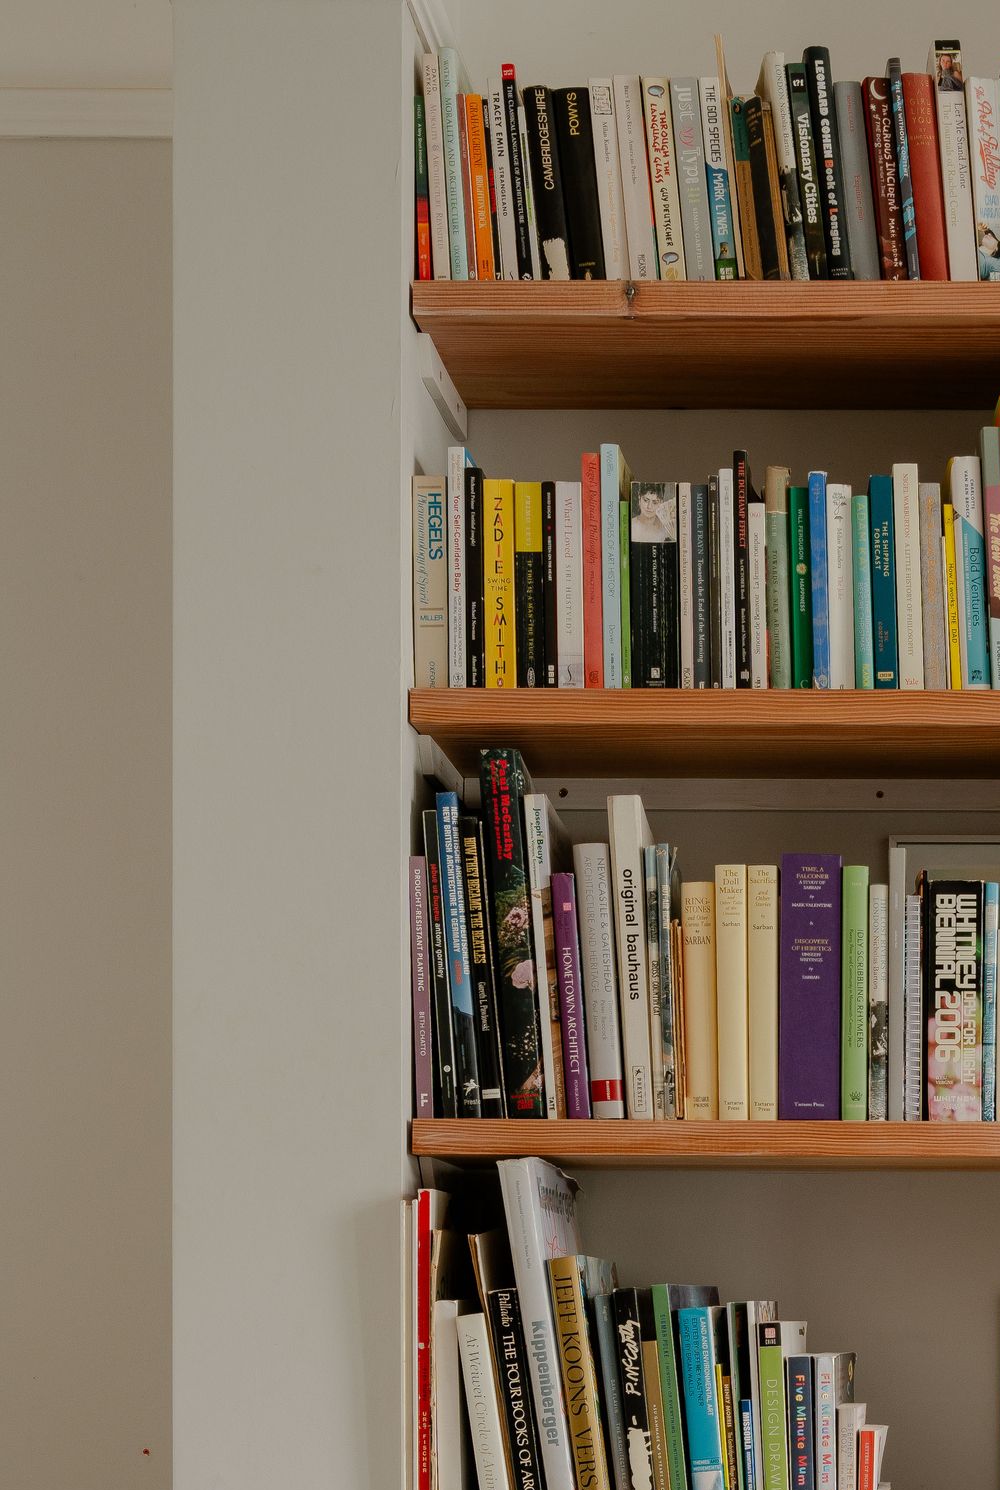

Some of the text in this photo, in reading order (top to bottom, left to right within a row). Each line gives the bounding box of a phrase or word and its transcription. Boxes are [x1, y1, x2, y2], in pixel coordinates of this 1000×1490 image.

[566, 92, 580, 135] POWYS
[814, 60, 828, 115] LEONARD
[445, 98, 455, 144] MORALITY
[534, 89, 554, 190] CAMBRIDGESHIRE
[650, 103, 663, 183] LANGUAGE GLASS
[659, 111, 669, 157] THROUGH
[705, 86, 721, 163] THE GOD SPECIES
[820, 119, 832, 159] COHEN
[448, 148, 456, 167] AND
[492, 92, 507, 216] TRACEY EMIN STRANGELAND
[797, 113, 818, 223] Visionary Cities
[824, 159, 835, 189] Book
[449, 170, 460, 234] ARCHITECTURE
[660, 188, 674, 246] GUY DEUTSCHER
[713, 173, 728, 236] MARK LYNAS
[827, 192, 838, 205] of
[829, 208, 841, 256] Longing
[416, 493, 429, 605] Phenomenology of Spirit
[428, 492, 443, 560] HEGEL'S
[453, 495, 462, 592] Your Self-Confident Baby
[493, 497, 504, 574] ZADIE
[970, 547, 982, 626] Bold Ventures
[493, 597, 507, 674] SMITH
[697, 634, 705, 663] Morning
[498, 760, 514, 860] Paul McCarthy
[533, 807, 546, 864] Joseph Beuys
[414, 869, 425, 992] DROUGHT-RESISTANT PLANTING
[463, 837, 486, 964] HOW THEY BECAME THE BEATLES
[621, 868, 641, 1000] original bauhaus
[935, 894, 956, 989] BIENNIAL
[956, 894, 977, 989] WHITNEY
[562, 947, 580, 1074] HOMETOWN ARCHITECT
[856, 929, 864, 1048] IDLY SCRIBBLING RHYMERS
[935, 991, 960, 1062] 2006
[963, 991, 976, 1085] DAY FOR NIGHT
[497, 1292, 513, 1327] Palladio
[552, 1274, 574, 1325] JEFF
[700, 1317, 708, 1335] LAND
[502, 1332, 518, 1359] THE
[560, 1332, 590, 1416] KOONS
[701, 1337, 709, 1349] AND
[505, 1363, 522, 1398] FOUR
[530, 1320, 561, 1447] Kippenberger
[702, 1351, 712, 1402] ENVIRONMENTAL
[766, 1379, 780, 1436] DESIGN
[821, 1372, 831, 1399] Five
[510, 1400, 528, 1447] BOOKS
[795, 1374, 807, 1485] Five Minute Mum
[821, 1404, 832, 1447] Minute
[516, 1449, 532, 1468] OF
[821, 1454, 832, 1484] Mum
